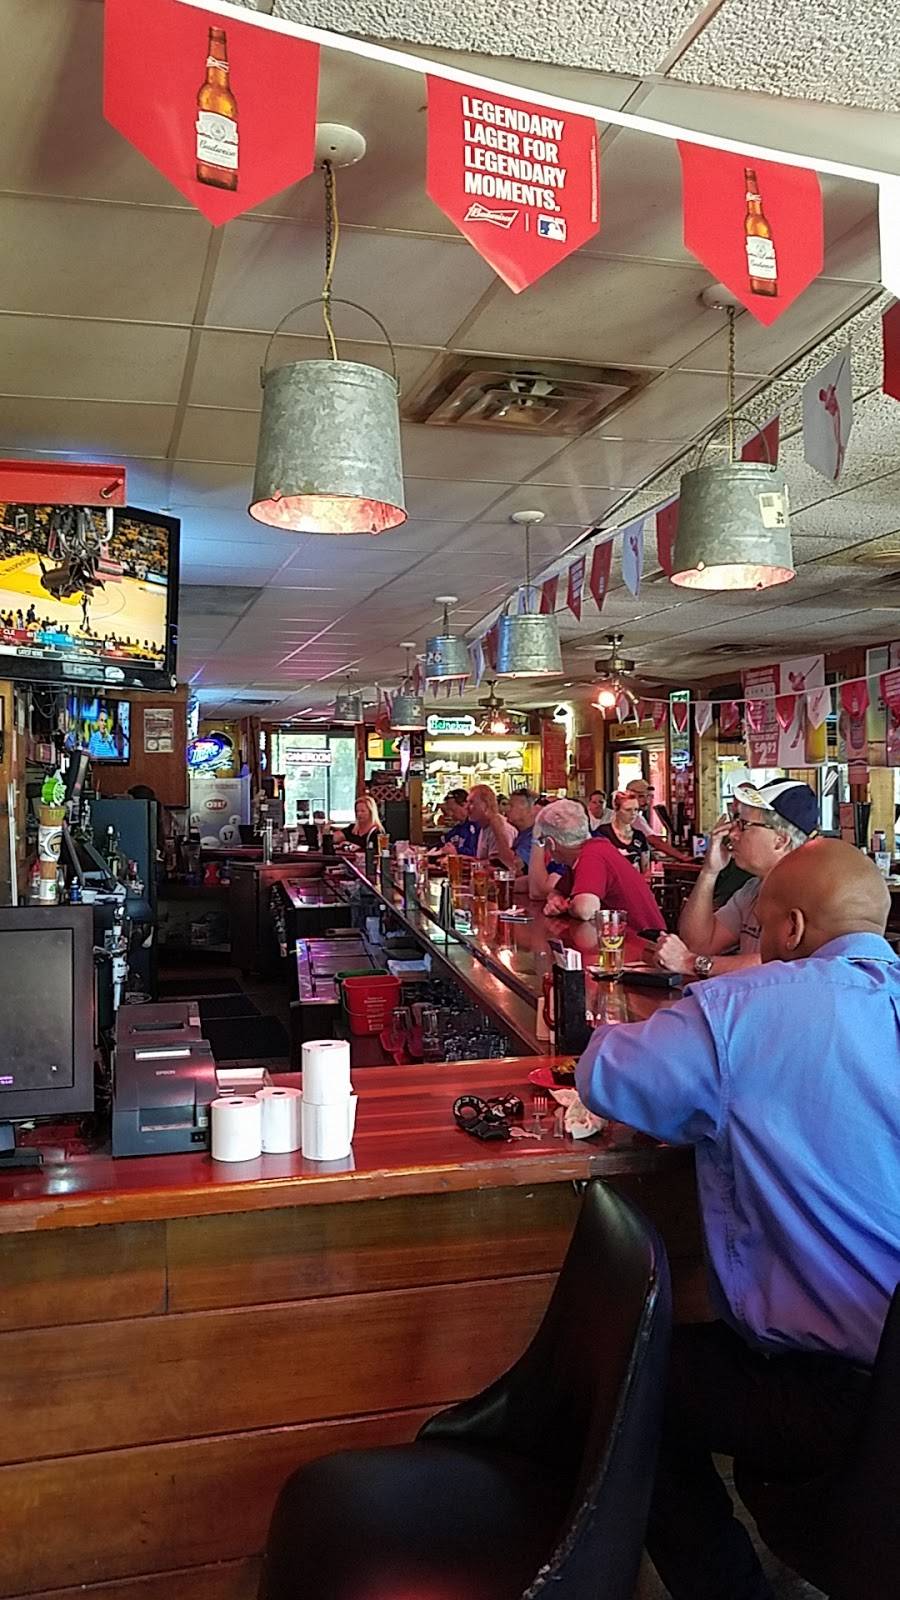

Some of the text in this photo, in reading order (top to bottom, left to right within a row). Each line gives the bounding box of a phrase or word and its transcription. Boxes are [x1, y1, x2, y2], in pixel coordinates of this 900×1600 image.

[462, 95, 565, 141] LEGENDARY
[464, 119, 560, 164] LAGER FOR
[464, 144, 567, 189] LEGENDARY
[464, 170, 561, 212] MOMENTS.
